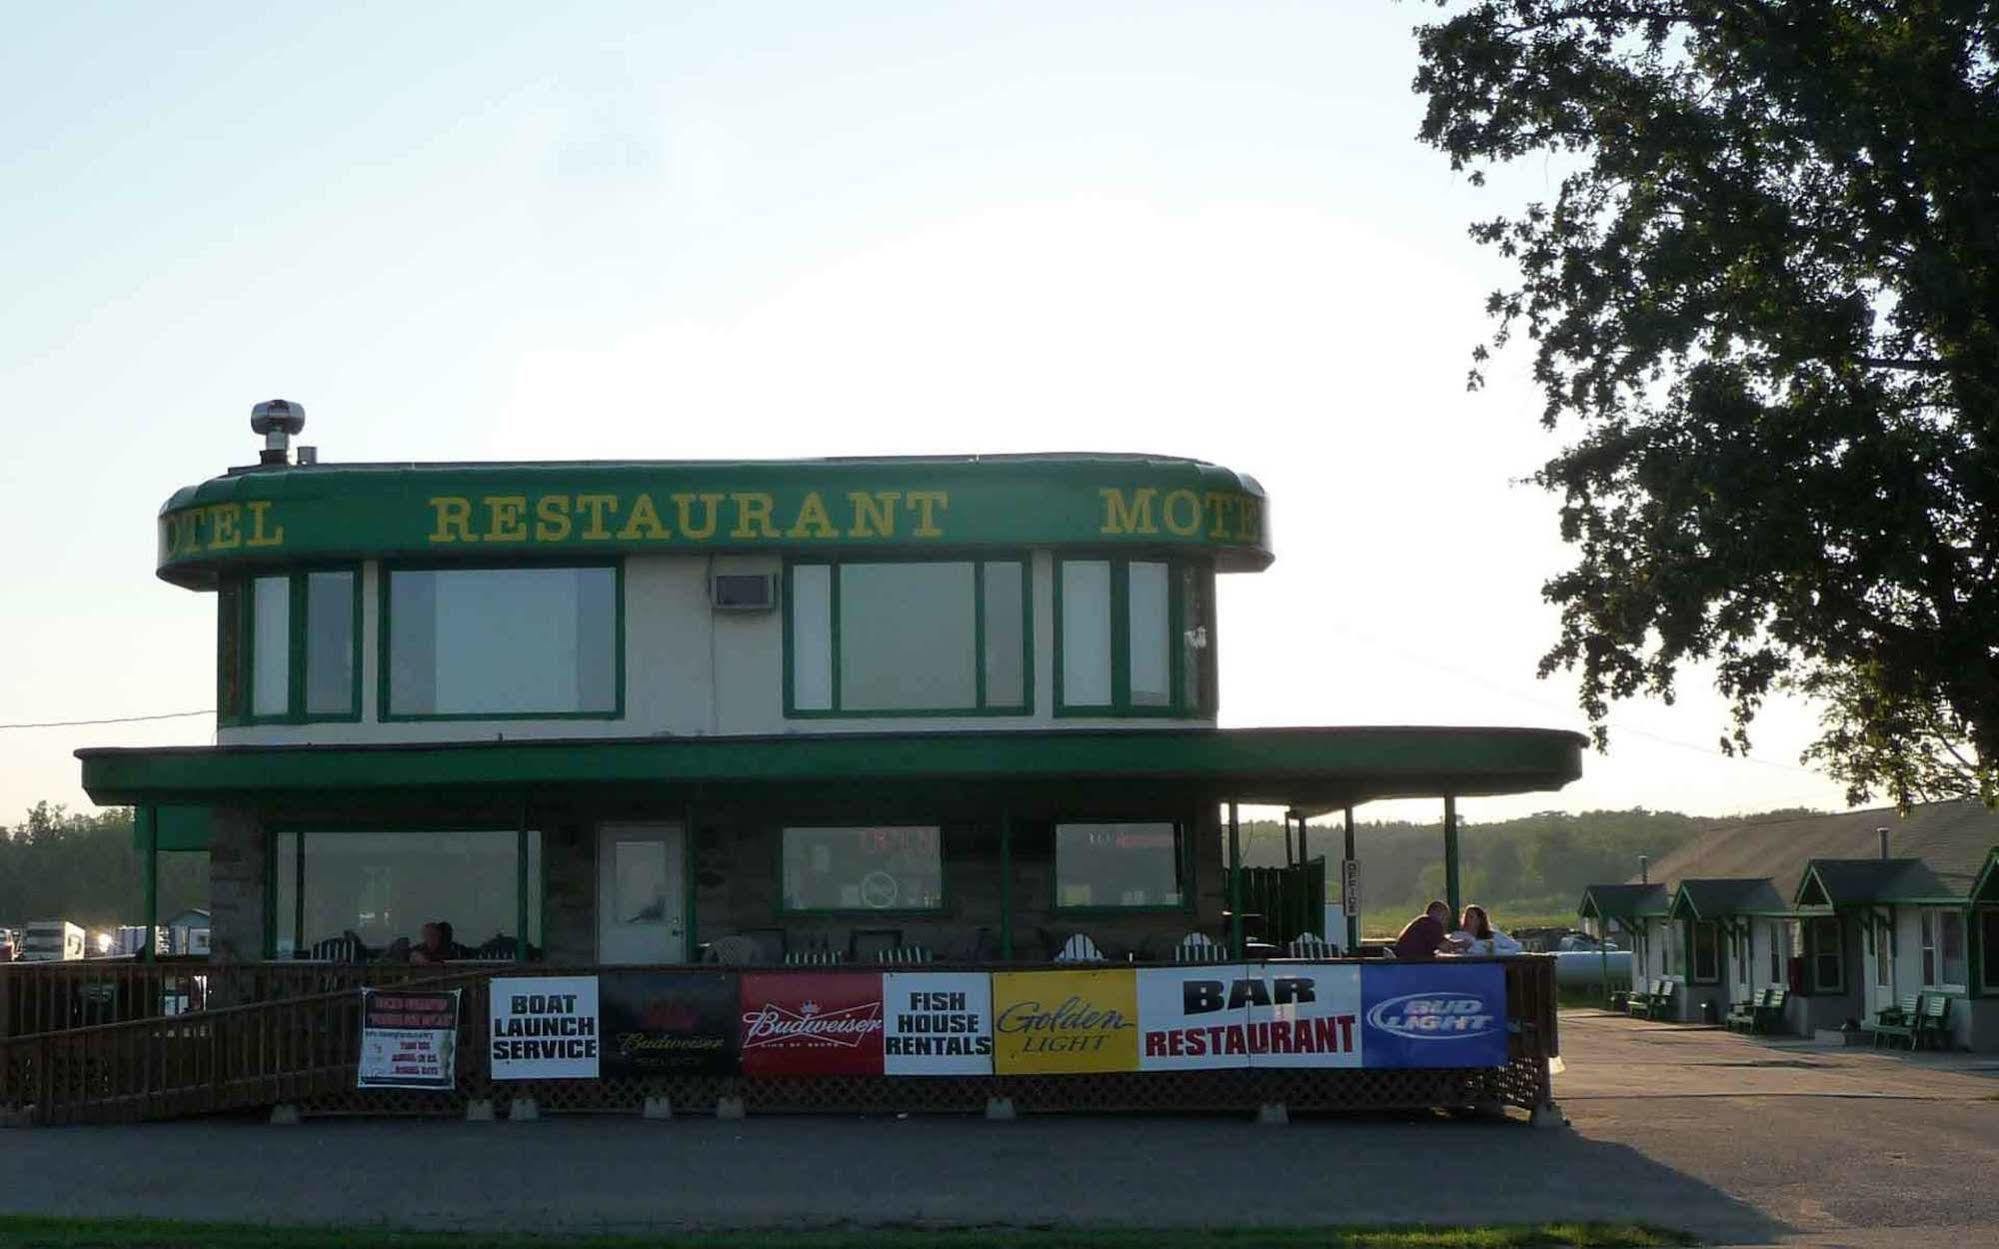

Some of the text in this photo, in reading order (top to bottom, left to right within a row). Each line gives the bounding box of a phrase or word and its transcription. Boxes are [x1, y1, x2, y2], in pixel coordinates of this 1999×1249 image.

[428, 491, 949, 543] RESTAURANT
[511, 995, 577, 1015] BOAT
[910, 992, 966, 1011] FISH
[1183, 978, 1316, 1015] BAR
[997, 997, 1135, 1033] Golden
[1403, 999, 1482, 1015] BUD
[494, 1017, 595, 1038] LAUNCH
[743, 1008, 883, 1040] Budweiser
[897, 1014, 979, 1034] HOUSE
[1385, 1015, 1495, 1031] LIGHT
[886, 1036, 991, 1056] RENTALS
[1023, 1034, 1110, 1053] LIGHT
[1145, 1016, 1356, 1057] RESTAURANT
[492, 1039, 597, 1060] SERVICE
